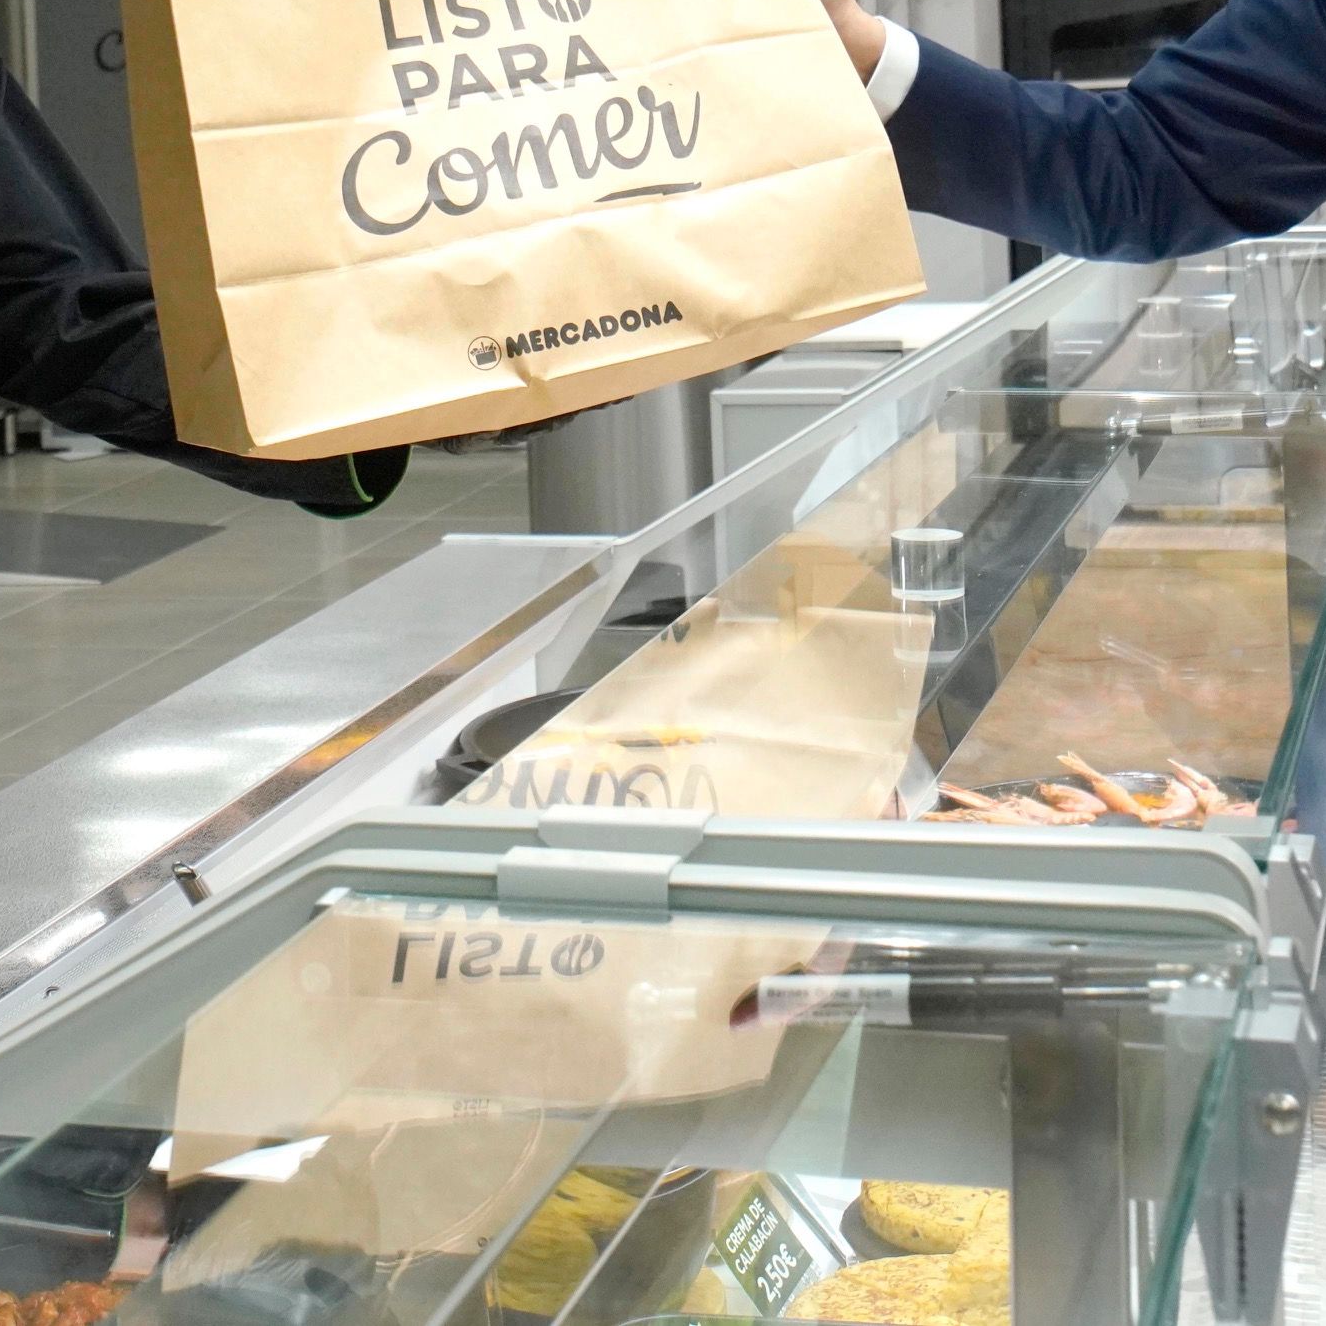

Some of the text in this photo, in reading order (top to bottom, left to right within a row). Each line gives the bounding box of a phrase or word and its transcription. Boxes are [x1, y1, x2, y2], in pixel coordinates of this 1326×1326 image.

[391, 34, 618, 116] PARA
[341, 84, 701, 236] Comer
[505, 301, 683, 359] MERCADONA
[725, 1197, 766, 1254] CREMA DE
[735, 1210, 779, 1275] CALABACÍN
[757, 1243, 797, 1303] 2,50€
